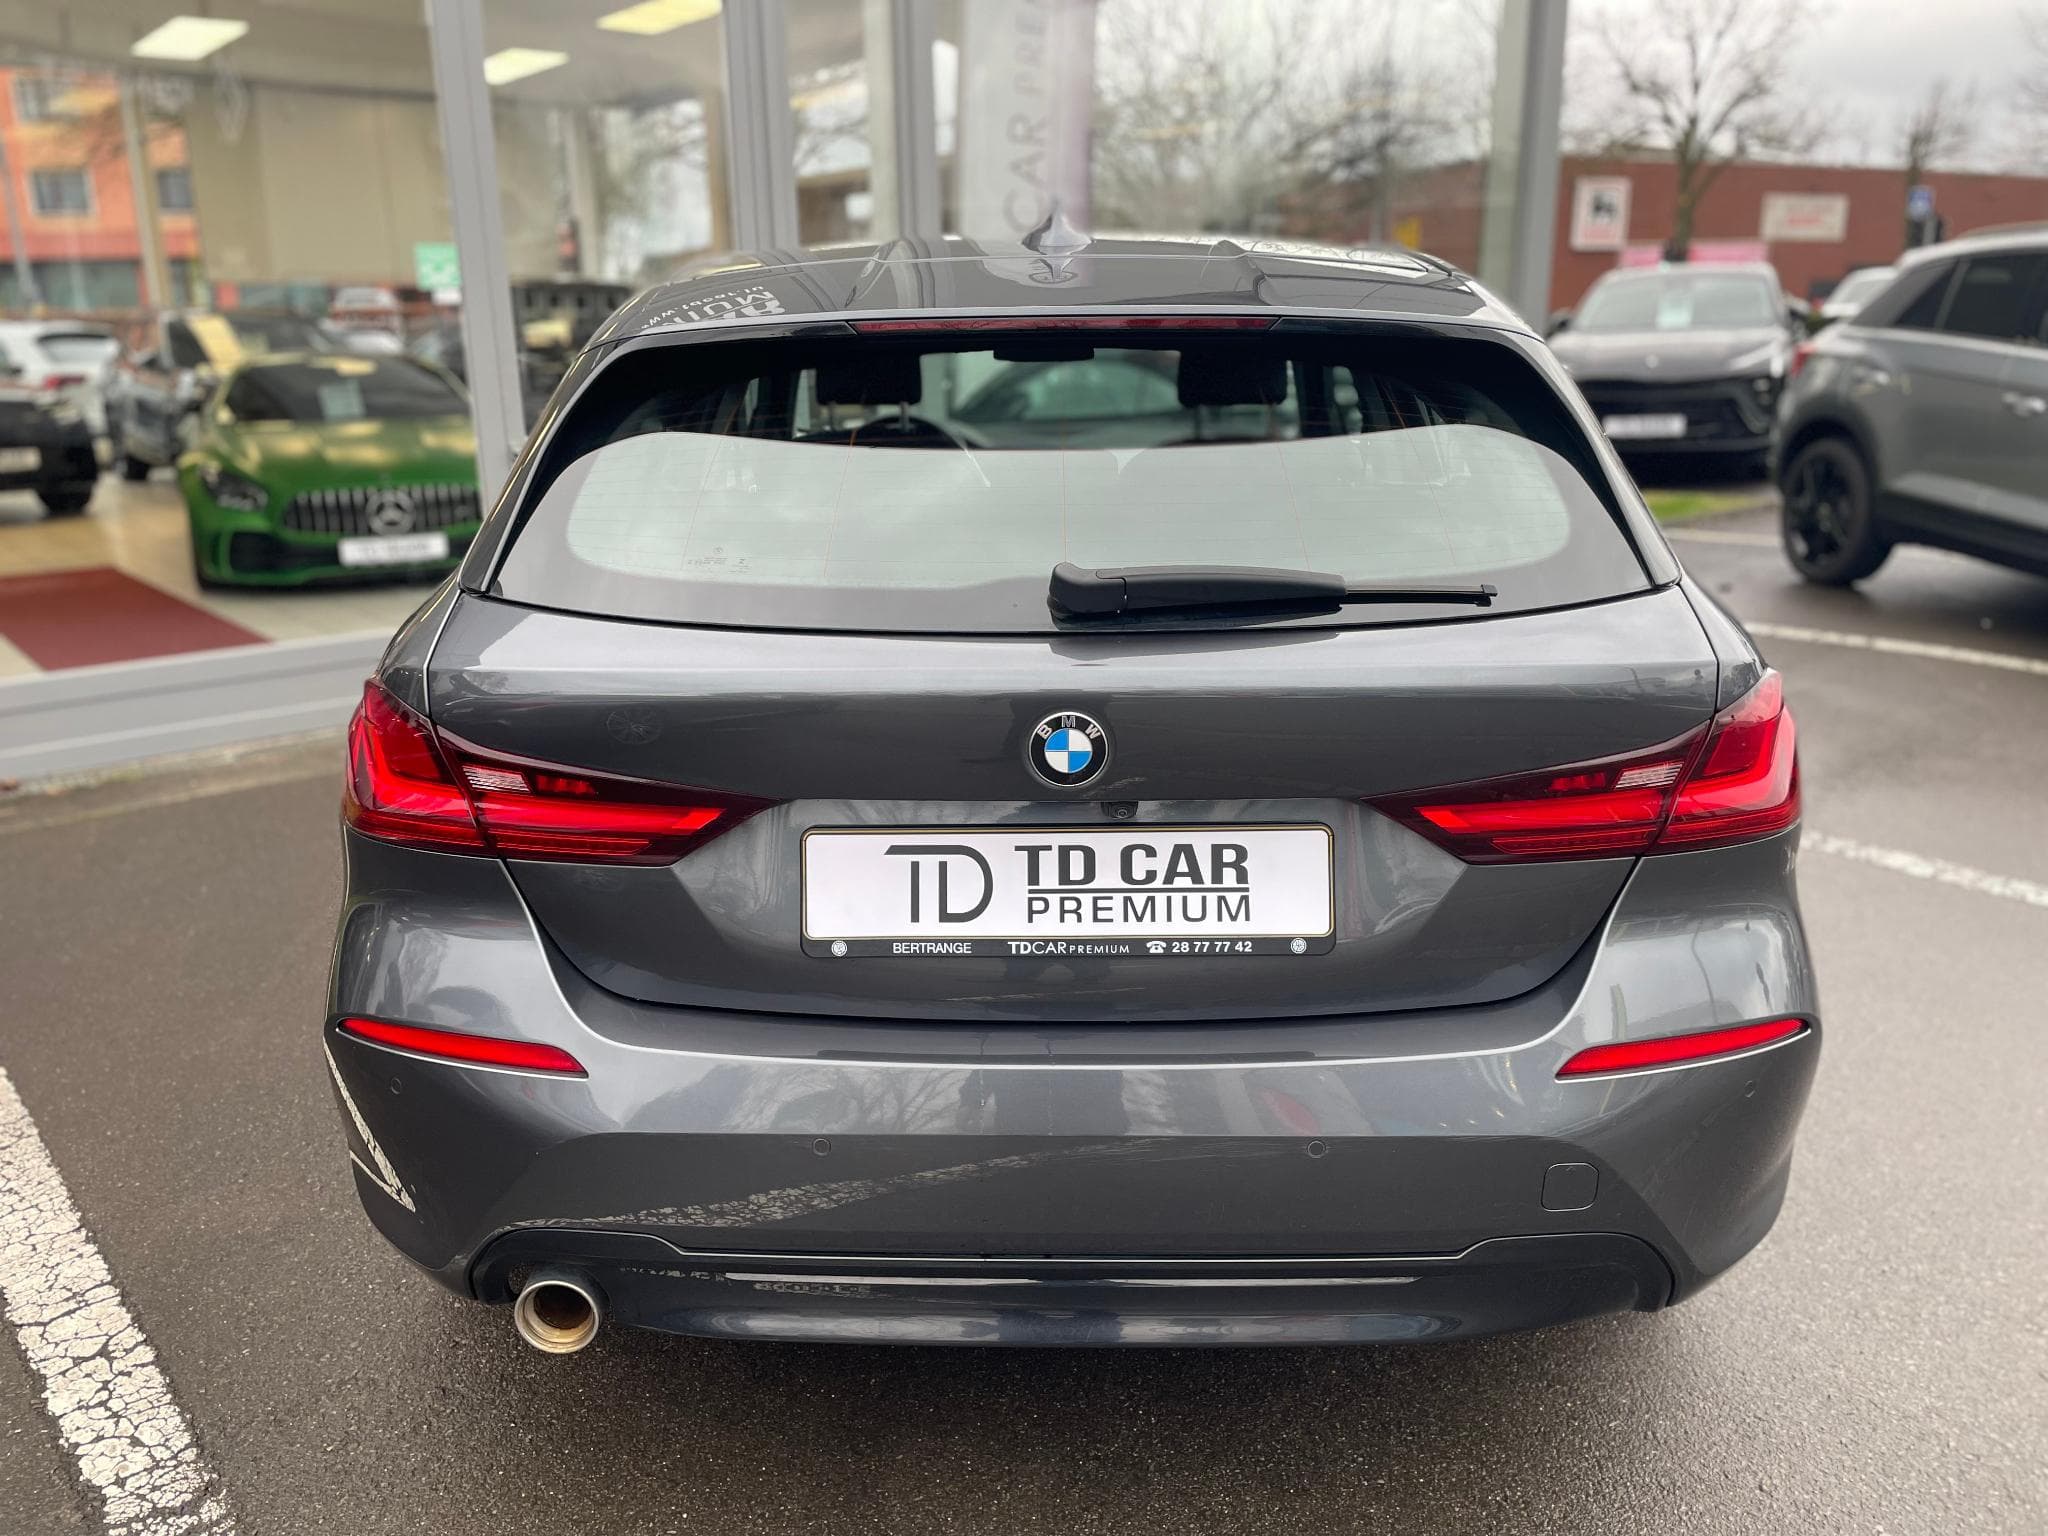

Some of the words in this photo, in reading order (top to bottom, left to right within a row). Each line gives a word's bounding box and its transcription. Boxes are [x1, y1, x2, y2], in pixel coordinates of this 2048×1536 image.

[1037, 715, 1101, 740] BMW
[1014, 845, 1096, 886] TD
[1120, 843, 1249, 886] CAR
[1027, 895, 1251, 924] PREMIUM
[893, 942, 972, 954] BERTRANGE
[1171, 941, 1190, 953] 28
[1193, 941, 1210, 953] 77
[1214, 941, 1231, 953] 77
[1234, 940, 1253, 953] 42
